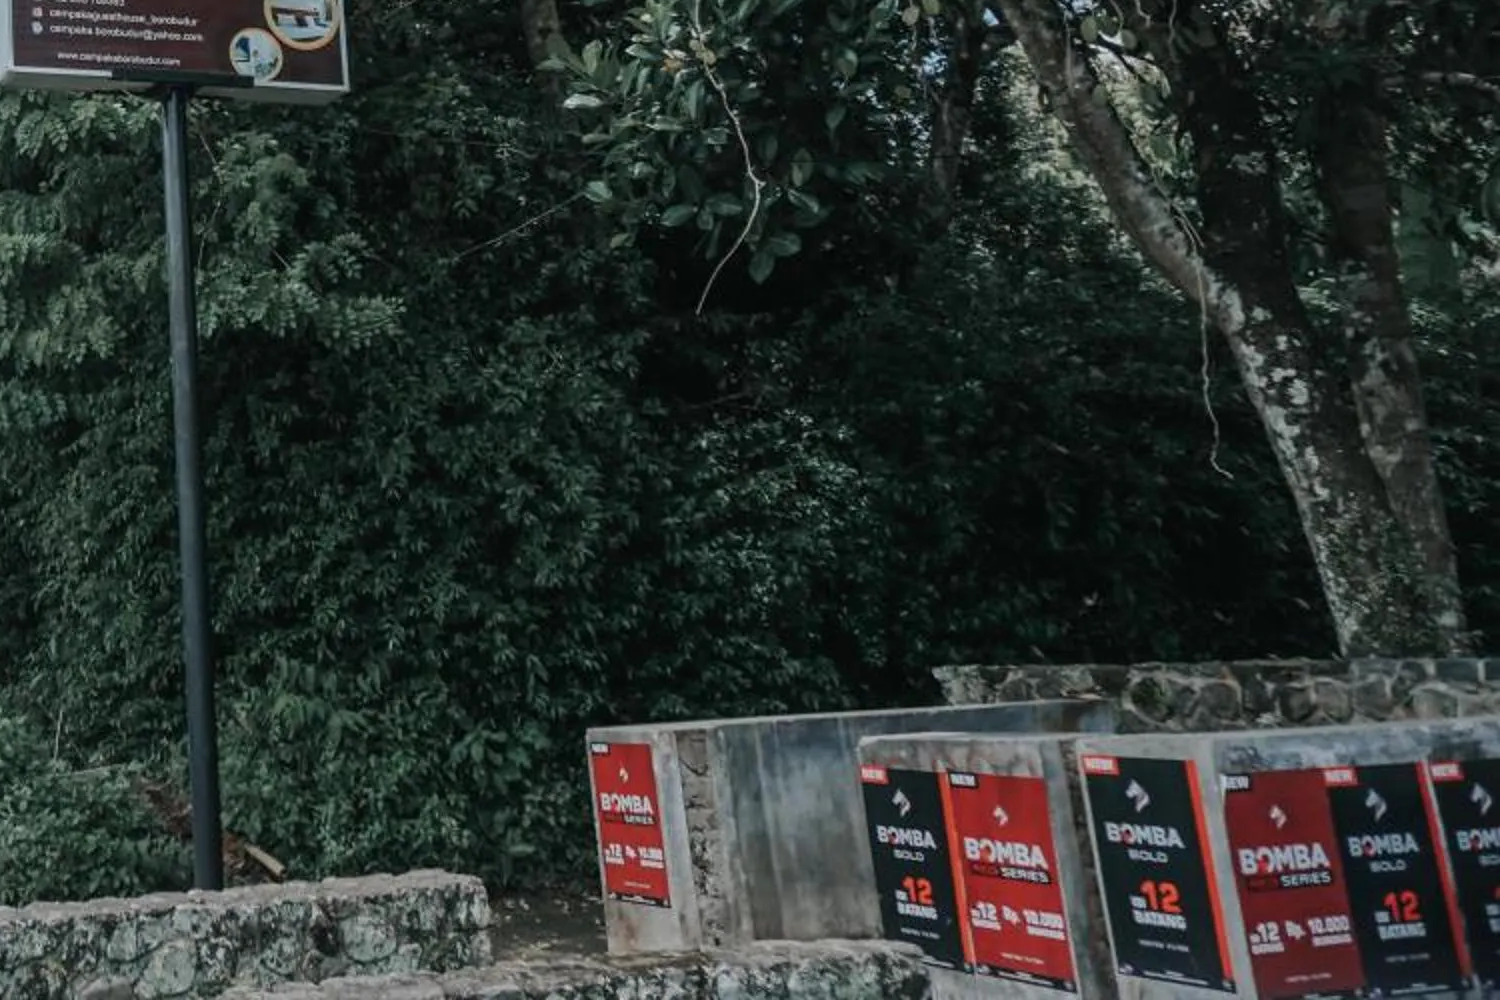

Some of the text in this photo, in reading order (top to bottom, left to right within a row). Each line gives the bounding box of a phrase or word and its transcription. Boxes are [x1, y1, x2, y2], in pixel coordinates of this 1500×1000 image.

[600, 792, 654, 815] BOMBA
[876, 825, 937, 850] BOMBA
[1104, 821, 1186, 849] BOMBA
[1348, 833, 1420, 857] BOMBA
[964, 837, 1049, 870] BOMBA
[1238, 842, 1331, 875] BOMBA
[1001, 867, 1051, 884] SERIES
[1280, 870, 1332, 888] SERIES
[903, 876, 934, 906] 12
[1140, 879, 1183, 914] 12
[977, 901, 998, 921] 12
[1383, 890, 1422, 922] 12
[1256, 920, 1281, 943] 12
